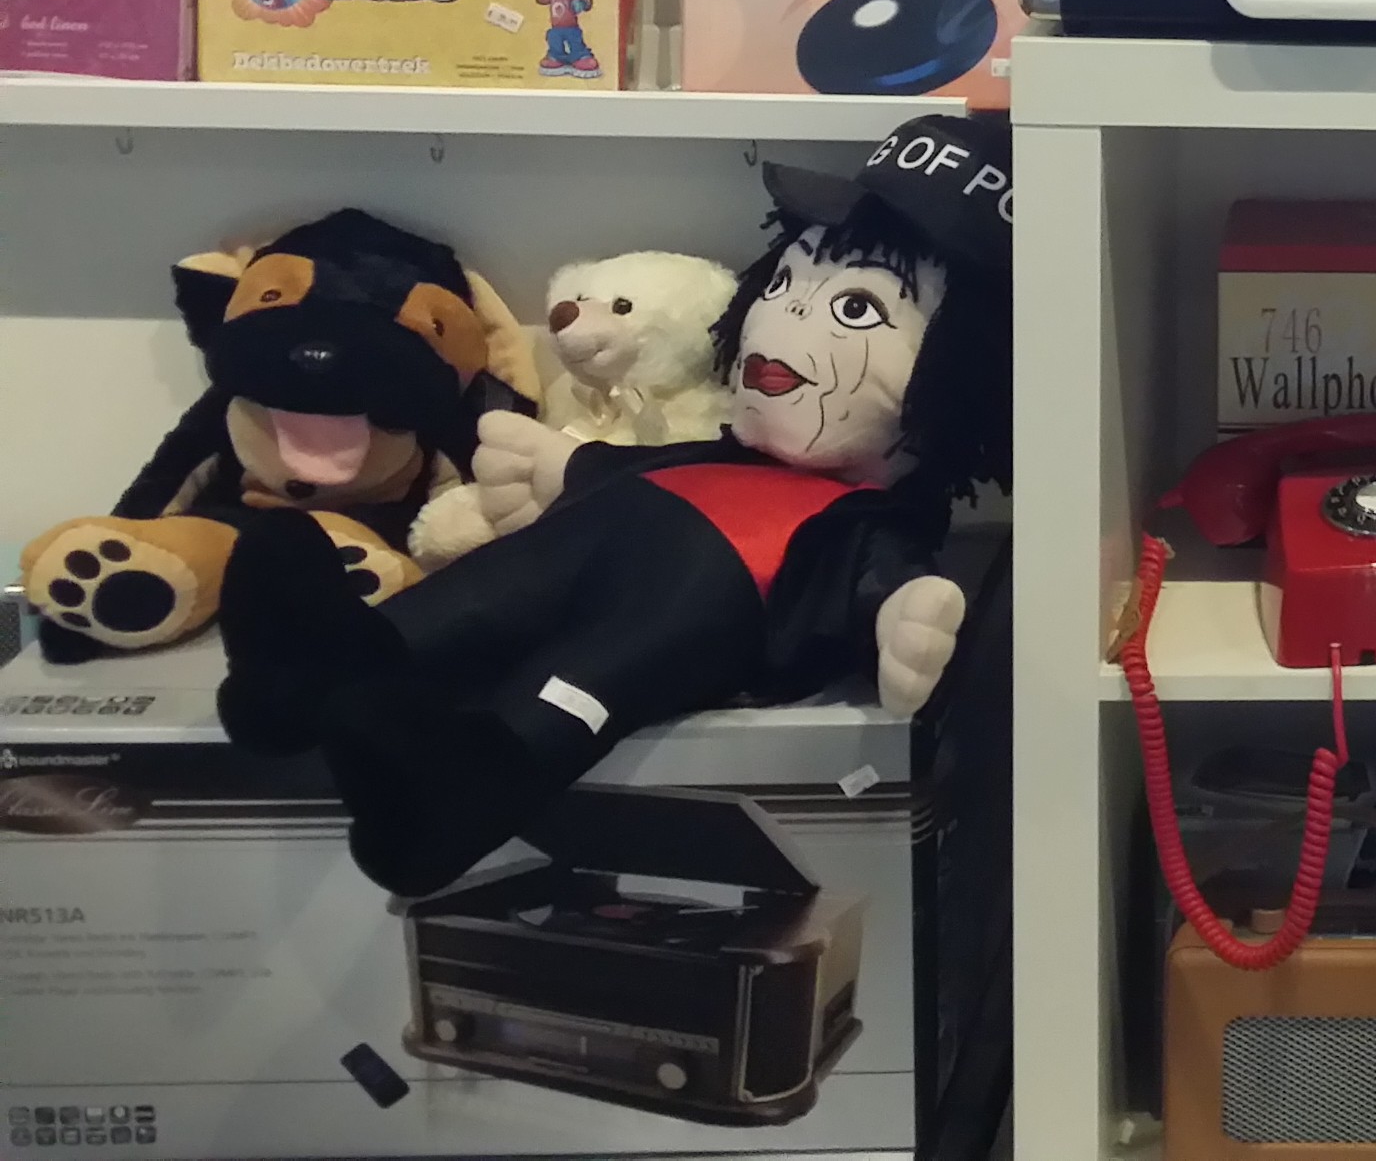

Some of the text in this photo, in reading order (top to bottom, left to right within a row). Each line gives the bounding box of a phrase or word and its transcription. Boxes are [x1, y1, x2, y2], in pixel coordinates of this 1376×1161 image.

[897, 137, 1013, 224] OF PO
[1261, 308, 1322, 353] 746
